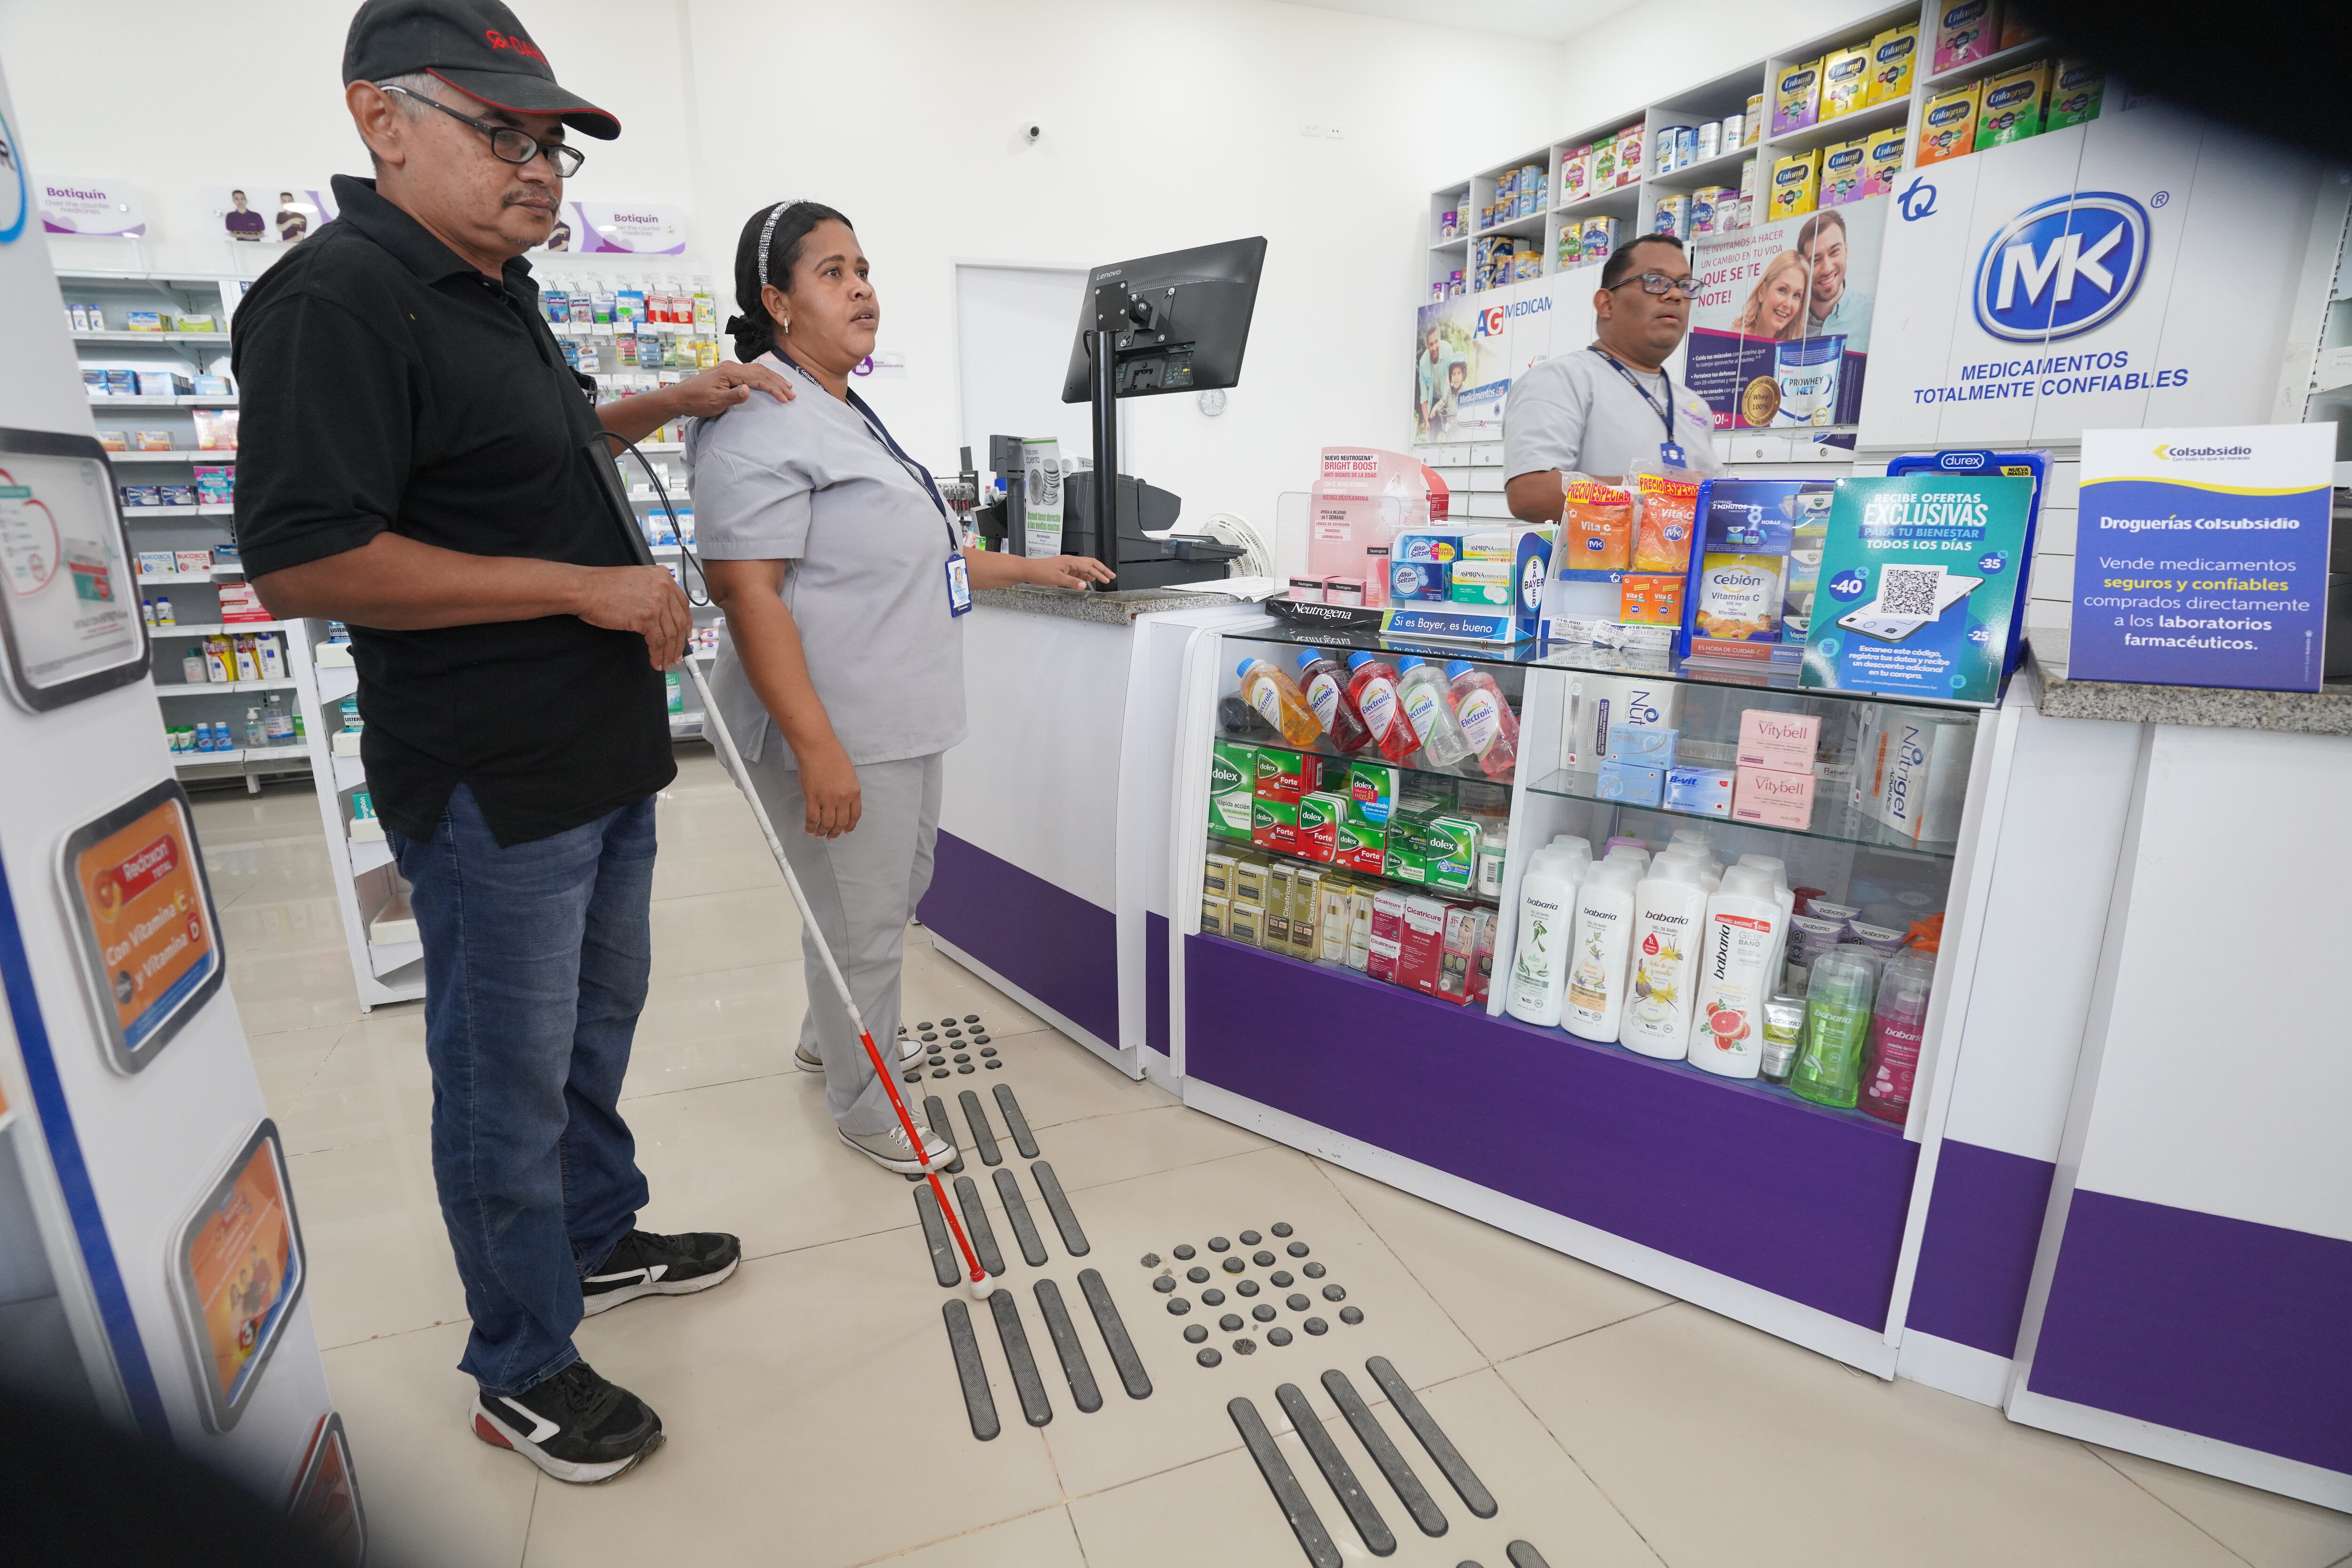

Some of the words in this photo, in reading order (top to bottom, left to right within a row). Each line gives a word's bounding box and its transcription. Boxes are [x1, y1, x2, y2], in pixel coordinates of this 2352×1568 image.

[47, 187, 106, 200] Botiquín
[614, 214, 659, 224] Botiquín
[1712, 238, 1750, 254] INVITAMOS
[1758, 230, 1783, 243] HACER
[1701, 260, 1711, 269] UN
[1713, 253, 1740, 266] CAMBIO
[1754, 248, 1763, 258] TU
[1765, 244, 1783, 255] VIDA
[1996, 221, 2124, 310] MK
[1096, 270, 1121, 281] Lenovo
[1698, 290, 1732, 308] NOTE!
[1473, 306, 1504, 339] AG
[1961, 350, 2129, 381] MEDICAMENTOS
[1789, 376, 1824, 386] PROWHEY
[1913, 381, 2034, 404] TOTALMENTE
[2041, 368, 2189, 396] CONFIABLES
[1459, 389, 1495, 404] Medicamentos
[2169, 446, 2252, 456] Colsubsidio
[1026, 455, 1040, 464] cuenta
[1324, 462, 1351, 470] BRIGHT
[1353, 462, 1378, 470] BOOST
[1946, 454, 1980, 466] durex
[1567, 483, 1589, 501] PRECIO
[1590, 483, 1629, 502] ESPECIAL
[1874, 494, 1917, 503] RECIBE
[1921, 493, 1981, 503] OFERTAS
[1027, 511, 1037, 521] Usted
[1037, 512, 1046, 521] tiene
[1046, 513, 1061, 523] derecho
[1863, 503, 1989, 526] EXCLUSIVAS
[1581, 521, 1601, 532] Vita
[2100, 514, 2192, 533] Droguerías
[2194, 518, 2300, 530] Colsubsidio
[1864, 528, 1895, 536] PARA
[1899, 528, 1913, 536] TU
[1916, 529, 1979, 538] BIENESTAR
[1867, 540, 1909, 549] TODOS
[1913, 541, 1937, 550] LOS
[1941, 538, 1972, 551] DÍAS
[2099, 557, 2154, 570] Vende
[2160, 558, 2296, 572] medicamentos
[1524, 578, 1544, 589] BAYER
[1713, 574, 1761, 586] Cebión
[2104, 578, 2172, 591] seguros
[2176, 579, 2188, 592] y
[2192, 578, 2289, 591] confiables
[1711, 592, 1750, 601] Vitamina
[1290, 602, 1352, 620] Neutrogena
[2083, 596, 2181, 609] comprados
[2186, 597, 2310, 612] directamente
[1395, 615, 1403, 627] Si
[1405, 618, 1415, 628] es
[1418, 618, 1446, 631] Bayer,
[1449, 622, 1460, 631] es
[1462, 621, 1493, 634] bueno
[2114, 617, 2124, 627] a
[2130, 614, 2153, 627] los
[2159, 615, 2273, 630] laboratorios
[2124, 633, 2258, 650] farmacéuticos.
[1859, 645, 1893, 653] Escanea
[1912, 649, 1942, 658] código,
[1863, 661, 1905, 670] descuento
[1906, 664, 1944, 673] adicional
[1362, 692, 1391, 714] Electrolit
[1461, 705, 1494, 728] Electrolit
[1759, 723, 1807, 739] Vitybell
[1260, 763, 1276, 772] dolex
[1824, 767, 1848, 776] Retinol
[1893, 725, 1919, 820] Nutrigel
[1212, 768, 1238, 782] dolex
[1669, 775, 1697, 785] B-vit
[1354, 781, 1372, 790] dolex
[1217, 799, 1233, 808] Rápida
[1314, 832, 1333, 842] Forte
[1340, 836, 1357, 845] dolex
[1430, 837, 1455, 851] dolex
[122, 842, 170, 883] Redoxon
[1283, 876, 1292, 917] Cicatricure
[1527, 897, 1558, 910] babaria
[1406, 907, 1442, 922] Cicatricure
[1645, 910, 1689, 925] babaria
[105, 940, 132, 967] Con
[128, 903, 176, 947] Vitamina
[1370, 938, 1397, 950] Cicatricure
[1714, 924, 1731, 980] babaria
